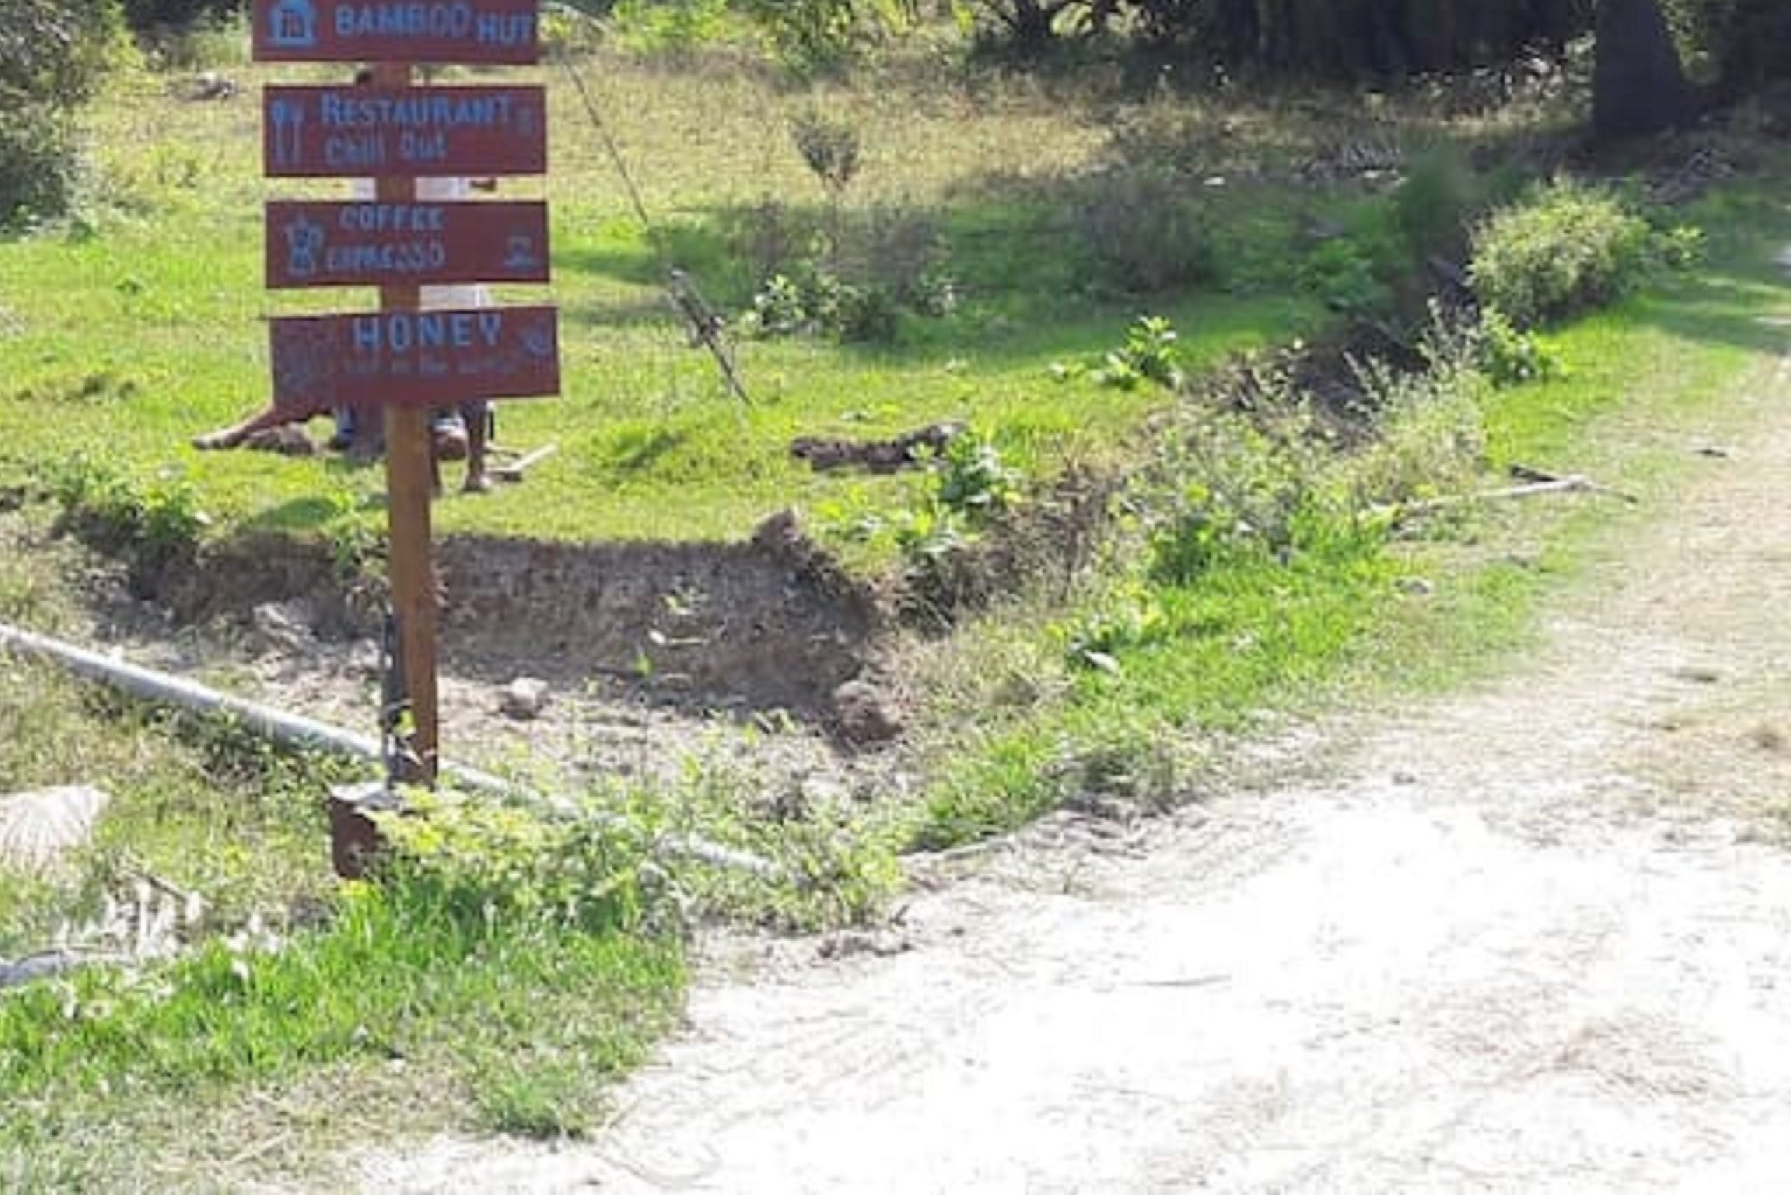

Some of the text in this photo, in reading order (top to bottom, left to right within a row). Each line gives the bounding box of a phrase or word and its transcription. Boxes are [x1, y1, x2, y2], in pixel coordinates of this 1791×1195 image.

[335, 0, 534, 43] BAMBOO HUT
[339, 205, 445, 231] COFFEE
[353, 314, 502, 351] HONEY
